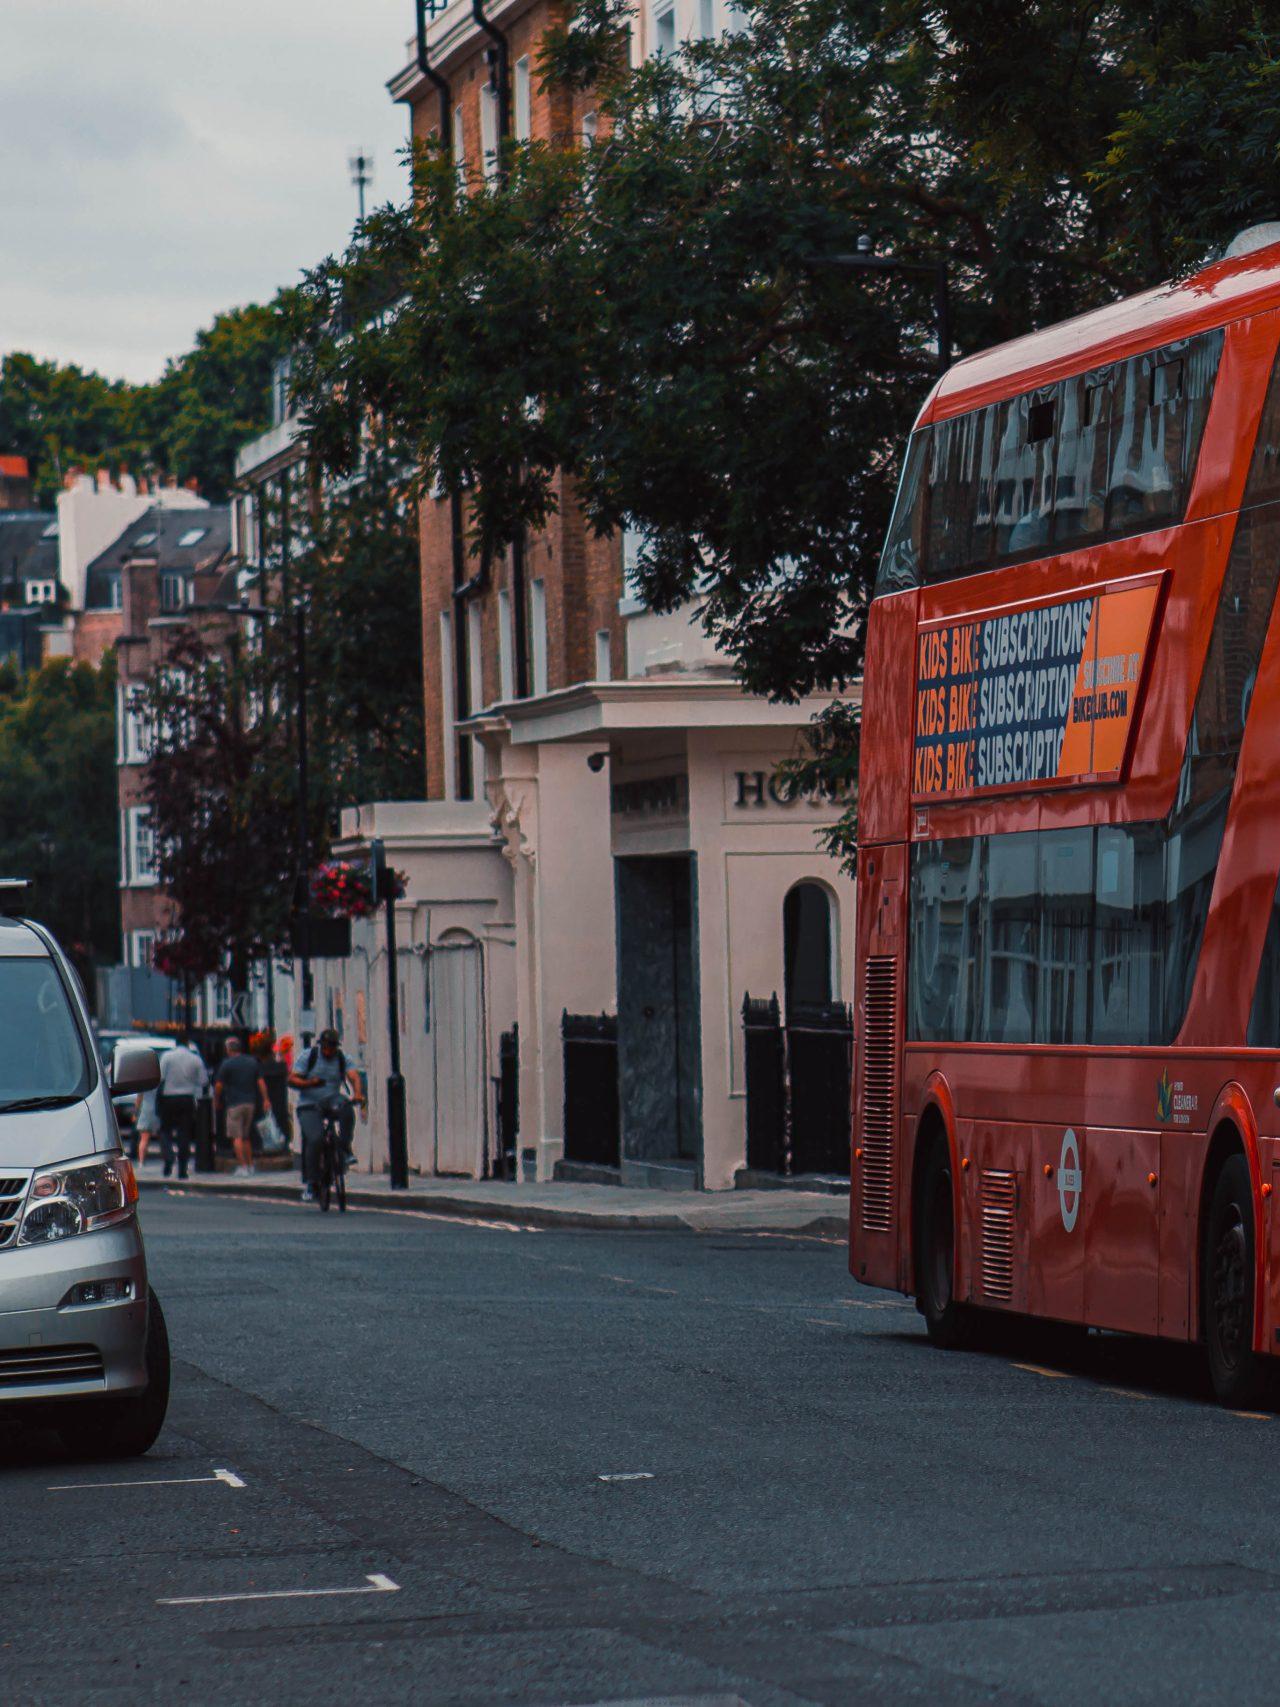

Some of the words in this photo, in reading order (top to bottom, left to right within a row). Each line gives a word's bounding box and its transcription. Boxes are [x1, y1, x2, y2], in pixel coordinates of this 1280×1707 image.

[919, 630, 947, 680] KIDS
[951, 623, 980, 675] BIKE
[982, 599, 1091, 671] SUBSCRIPTIONS
[917, 686, 945, 737] KIDS
[949, 680, 978, 733] BIKE
[914, 744, 942, 794] KIDS
[946, 740, 975, 792] BIKE
